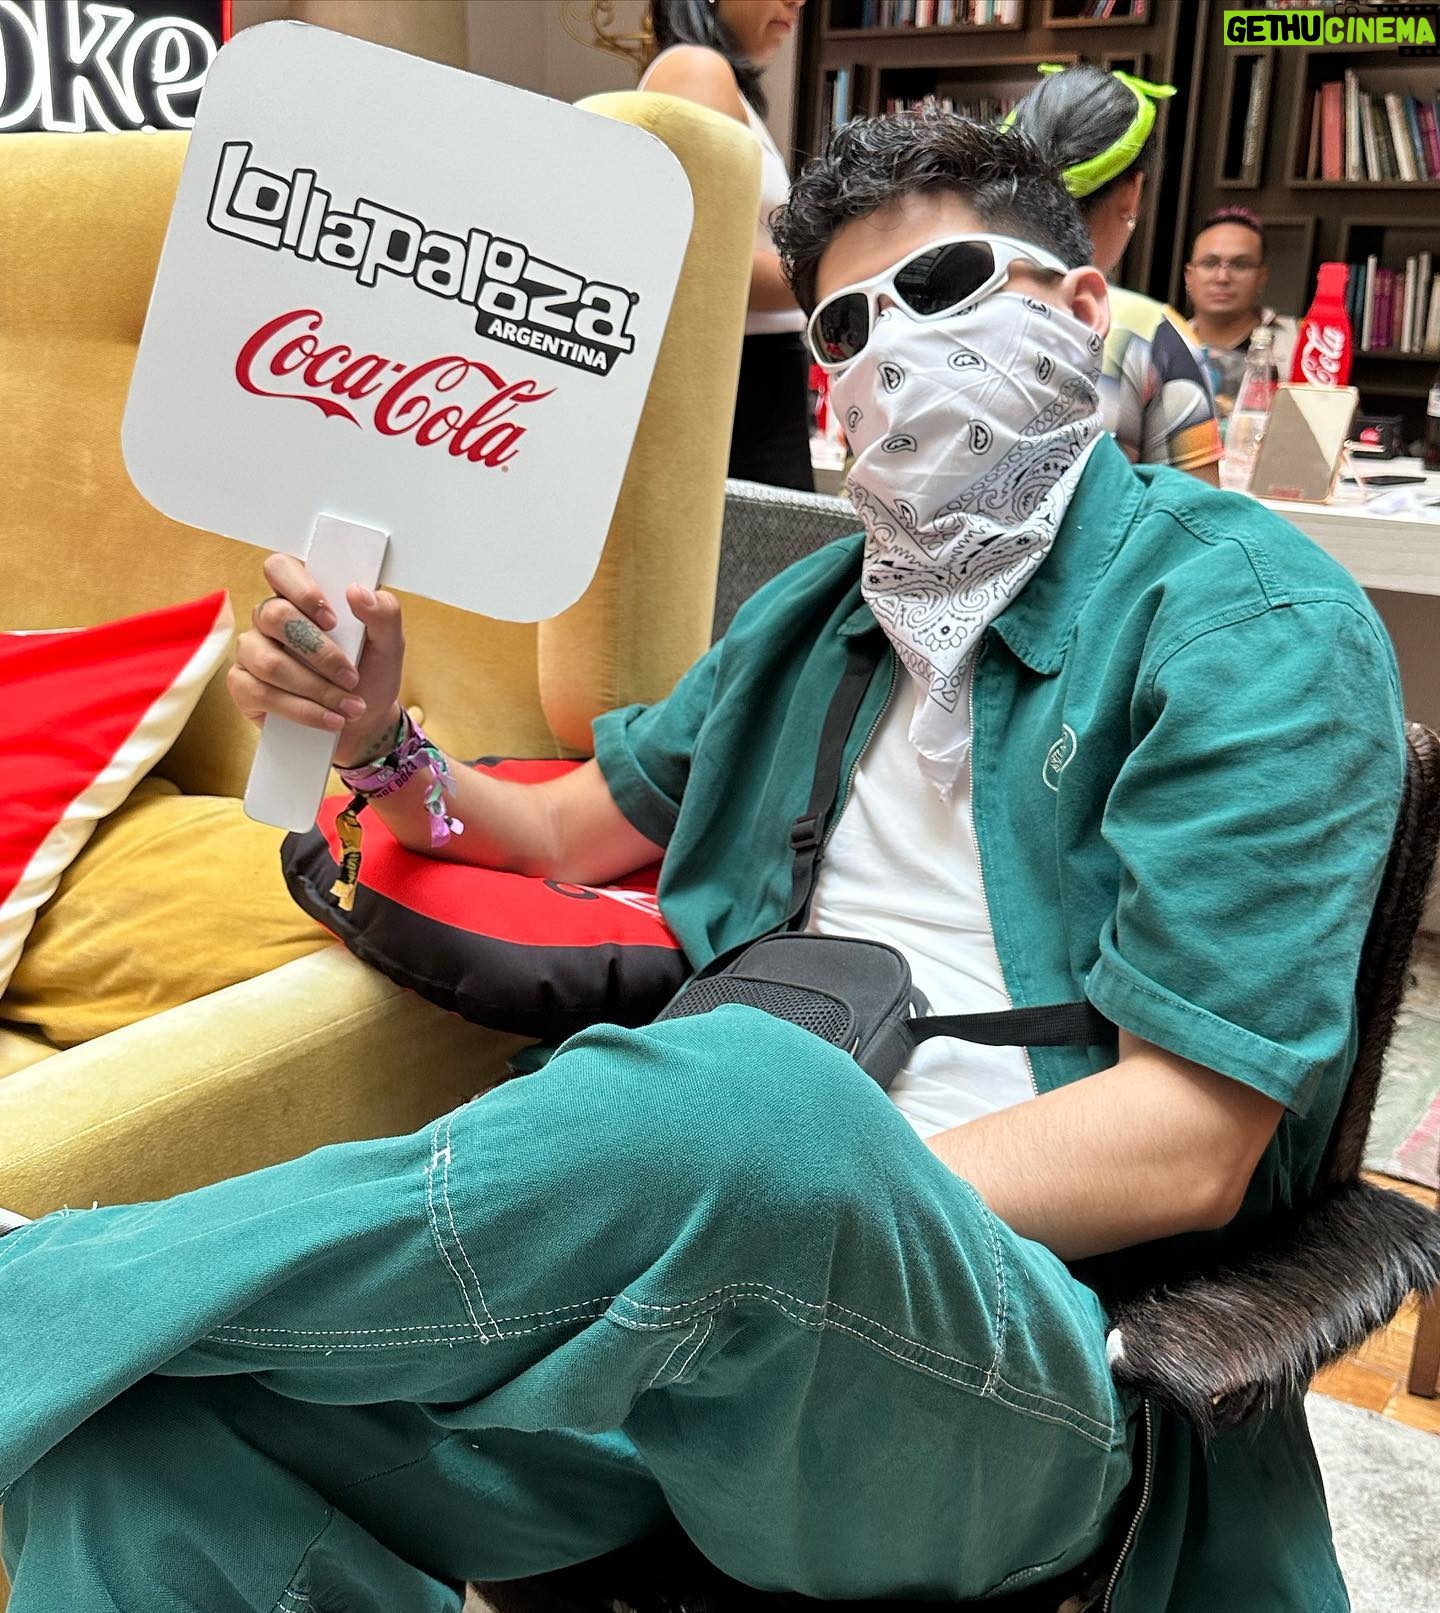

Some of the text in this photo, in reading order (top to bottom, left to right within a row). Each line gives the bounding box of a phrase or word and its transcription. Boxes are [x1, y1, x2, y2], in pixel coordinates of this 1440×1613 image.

[207, 141, 639, 354] Lollapalooza
[235, 309, 558, 468] Coca-Cola
[488, 319, 607, 370] ARGENTINA
